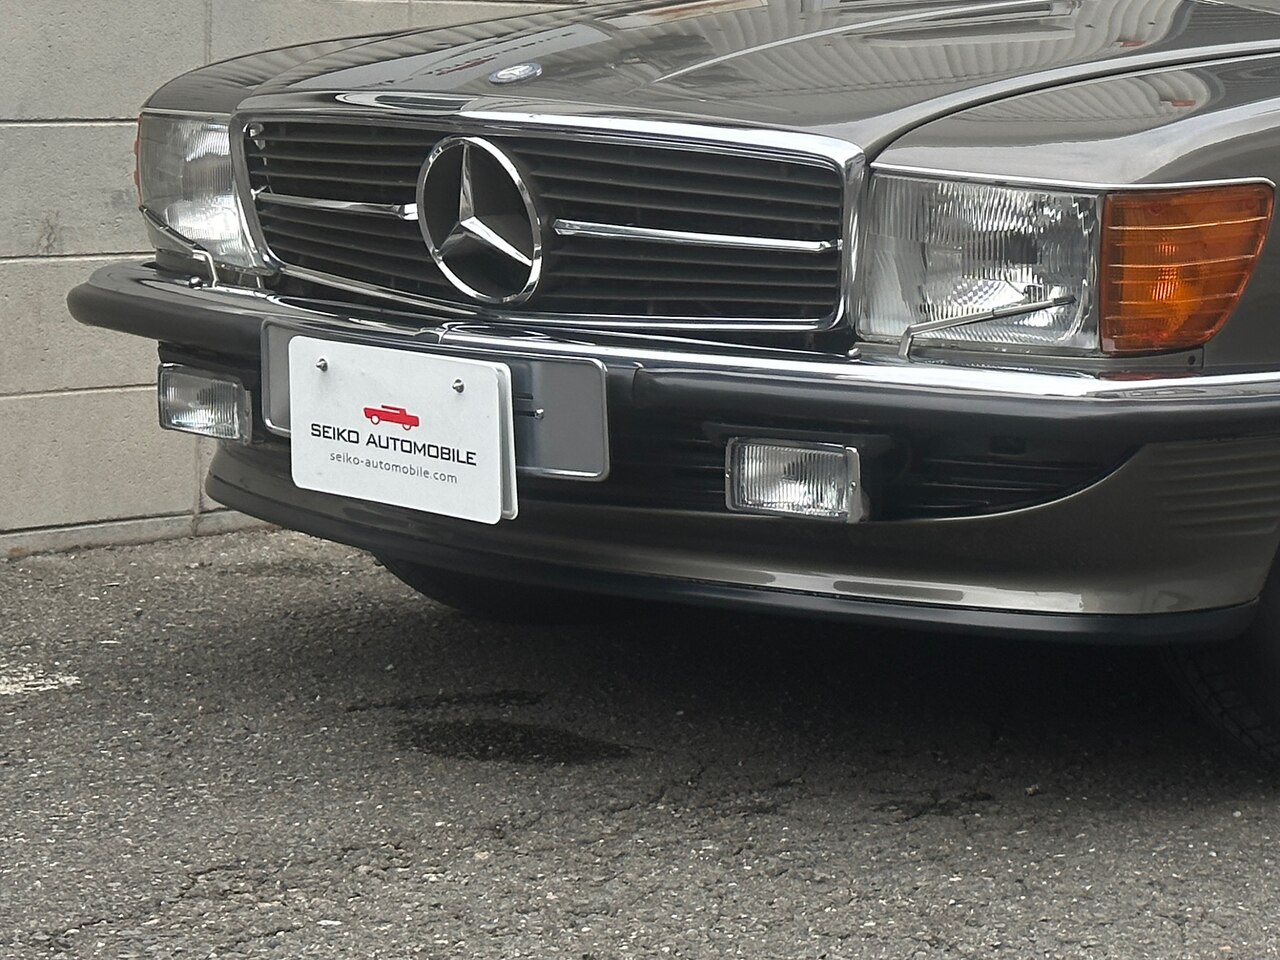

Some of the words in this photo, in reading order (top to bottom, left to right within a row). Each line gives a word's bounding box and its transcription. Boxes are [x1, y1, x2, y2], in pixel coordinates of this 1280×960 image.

[311, 423, 360, 444] SEIKO
[366, 433, 477, 466] AUTOMOBILE
[330, 452, 458, 484] seiko-automobile.com
